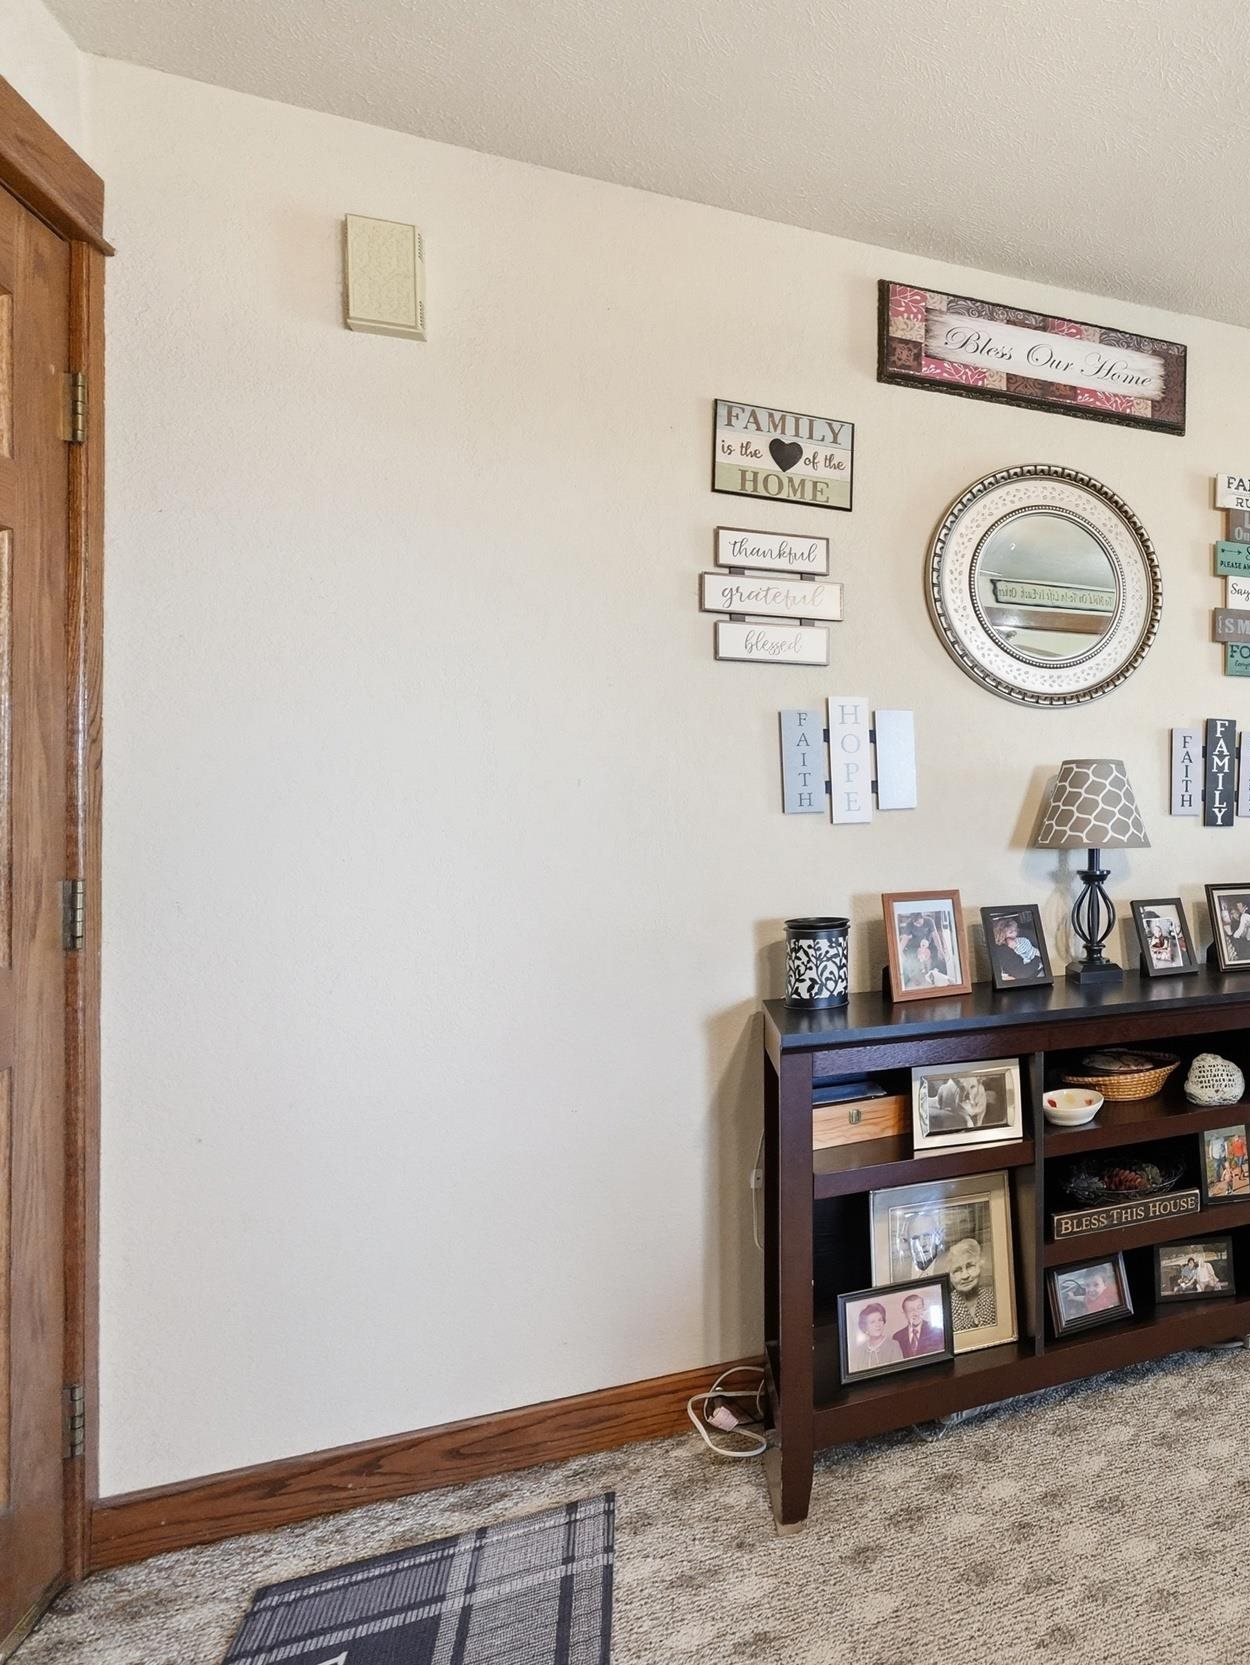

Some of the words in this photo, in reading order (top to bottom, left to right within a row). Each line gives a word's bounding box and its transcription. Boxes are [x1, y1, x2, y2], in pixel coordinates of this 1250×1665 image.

[944, 326, 1012, 361] Bless
[1026, 343, 1073, 373] Our
[1080, 353, 1152, 386] Home
[724, 404, 844, 445] FAMILY
[721, 440, 735, 455] is
[740, 441, 763, 459] the
[804, 452, 820, 471] of
[824, 454, 846, 471] the
[738, 468, 830, 504] HOME
[728, 537, 818, 565] thankful
[1220, 560, 1242, 570] PLEASE
[722, 585, 825, 609] grateful
[1231, 583, 1250, 601] Say
[745, 630, 802, 655] blessed
[796, 712, 814, 807] FAITH
[838, 704, 861, 812] HOPE
[1180, 735, 1193, 807] FAITH
[1211, 720, 1230, 825] FAMILY
[1060, 1213, 1107, 1234] BLESS
[1110, 1206, 1145, 1224] THIS
[1149, 1196, 1196, 1217] HOUSE
